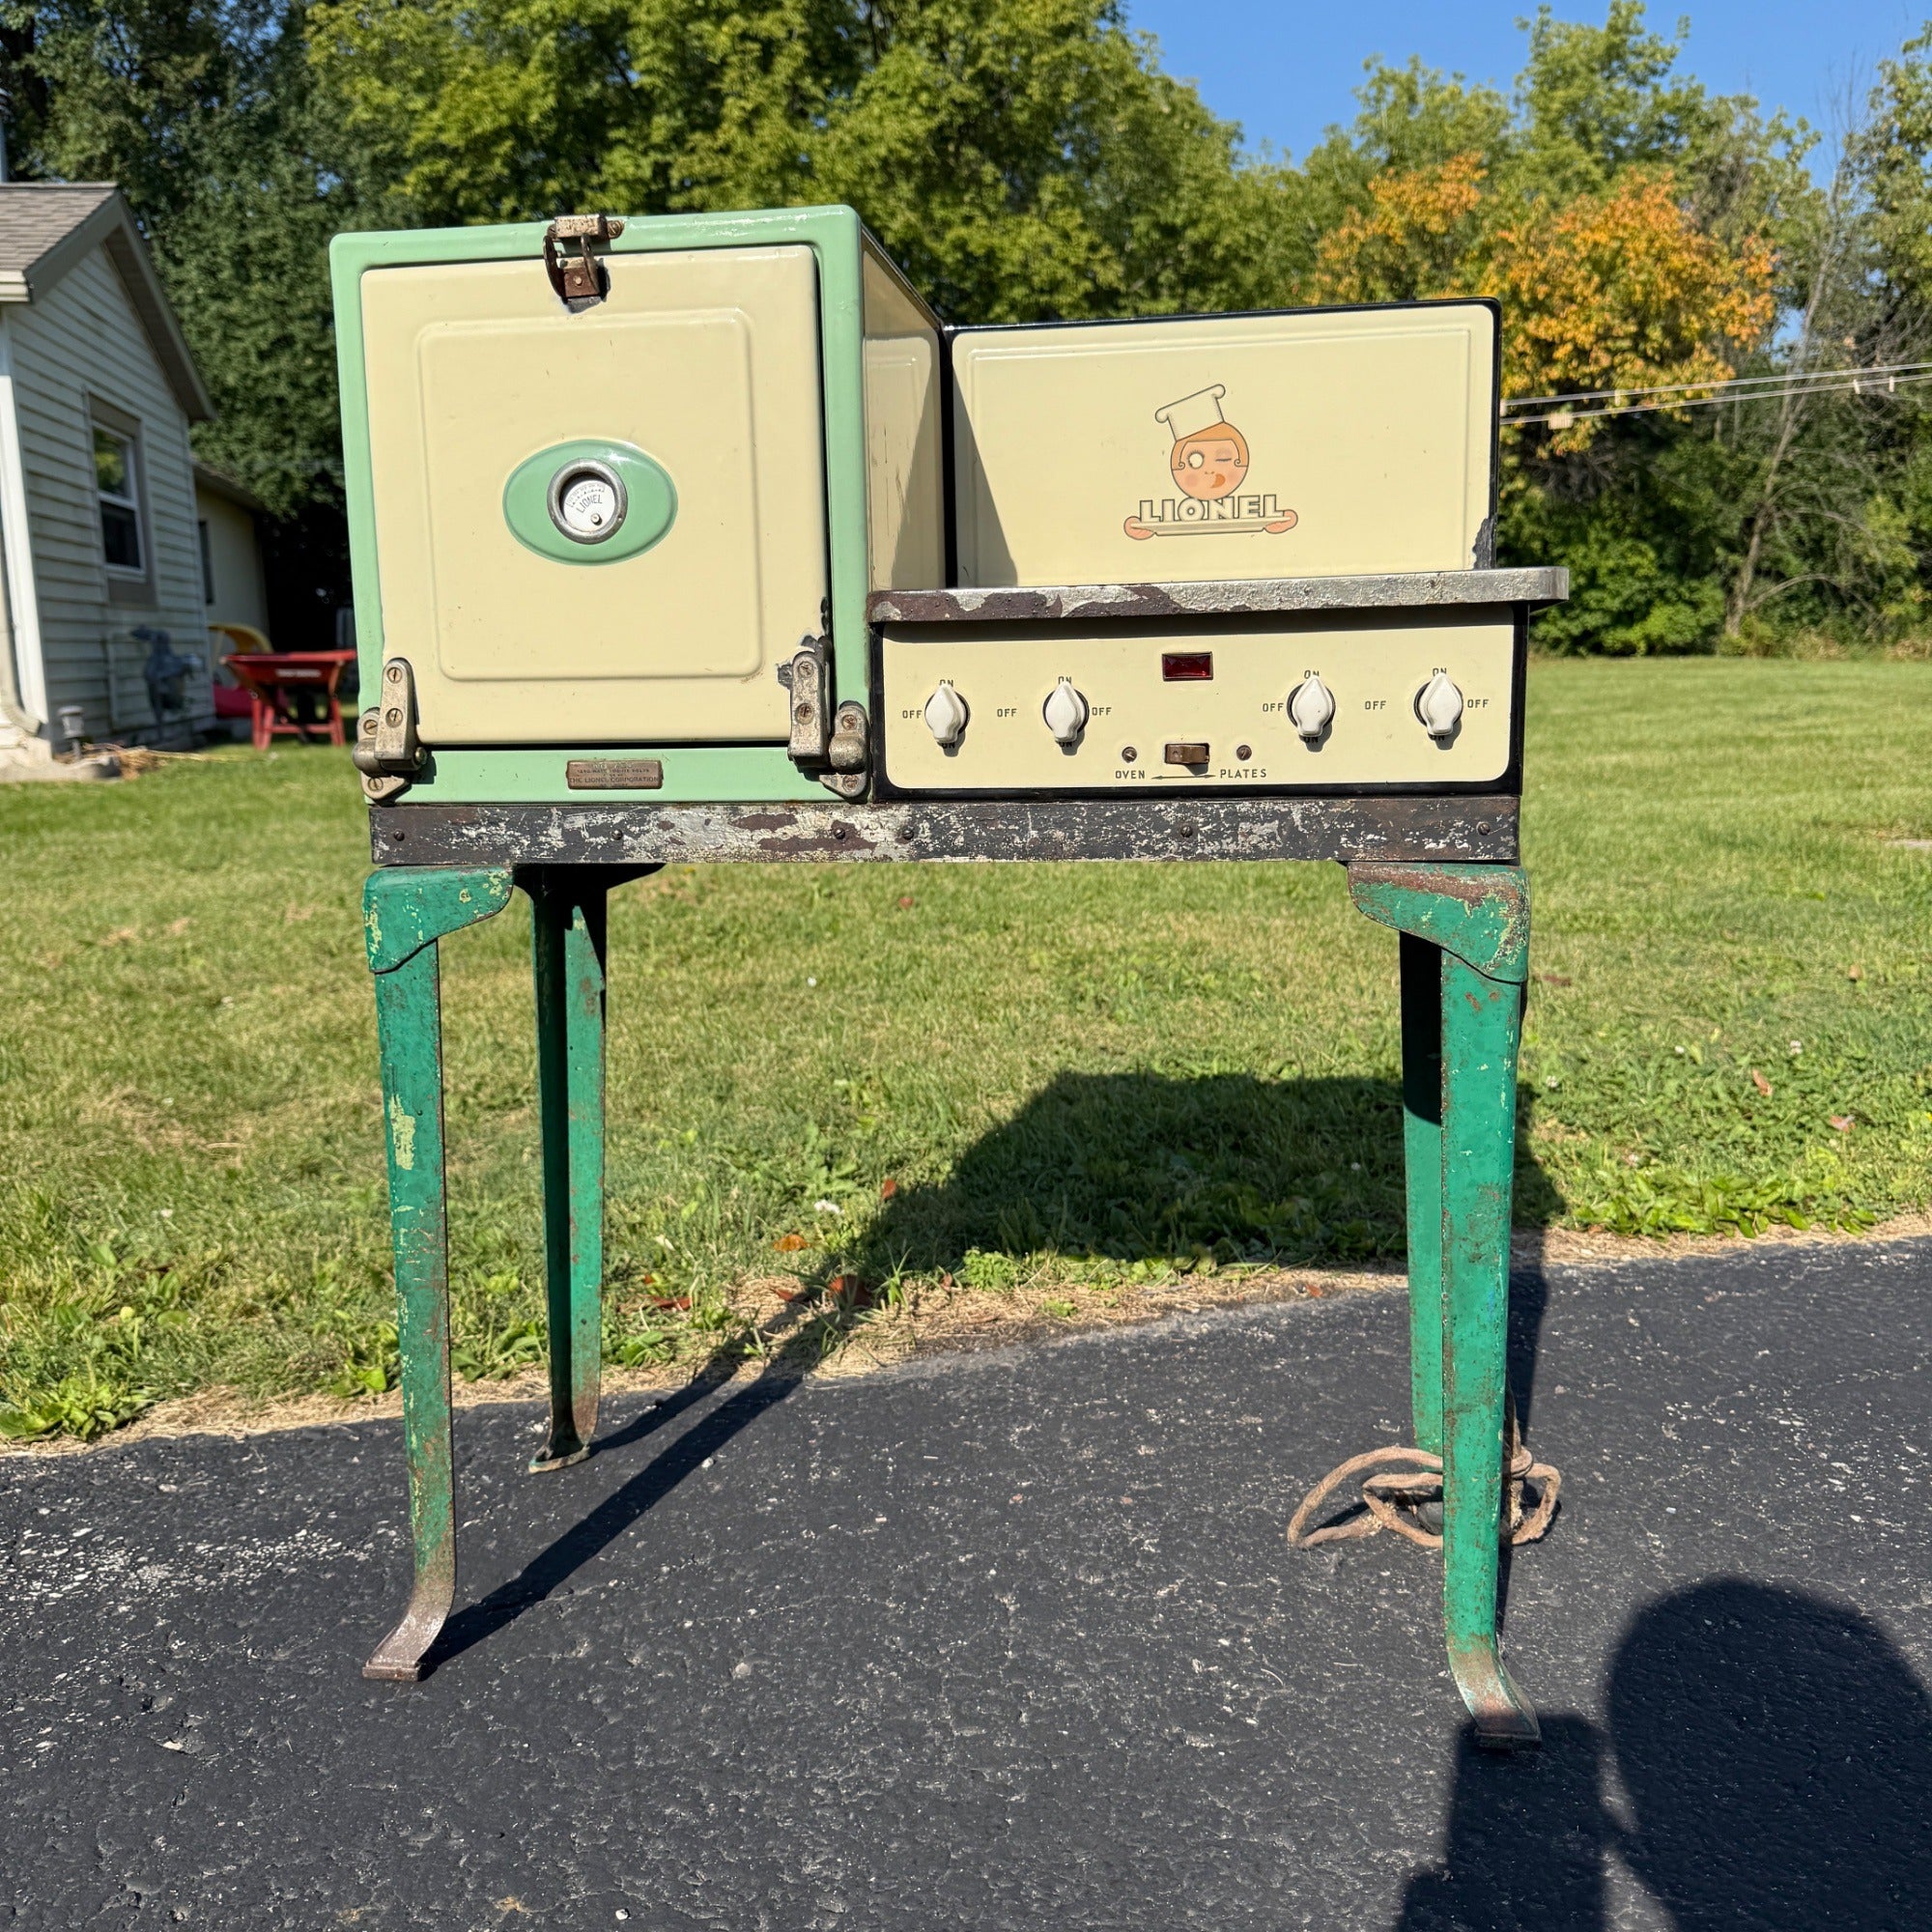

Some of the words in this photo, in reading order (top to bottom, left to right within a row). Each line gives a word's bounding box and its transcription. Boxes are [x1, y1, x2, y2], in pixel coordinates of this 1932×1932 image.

[576, 494, 603, 513] LIONEL
[1139, 495, 1285, 523] LIONEL
[1262, 702, 1284, 712] OFF
[1364, 700, 1386, 710] OFF
[1466, 699, 1490, 709] OFF
[902, 710, 923, 719] OFF
[996, 708, 1017, 718] OFF
[1092, 707, 1112, 716] OFF
[1115, 770, 1146, 780] OVEN
[1220, 768, 1267, 779] PLATES
